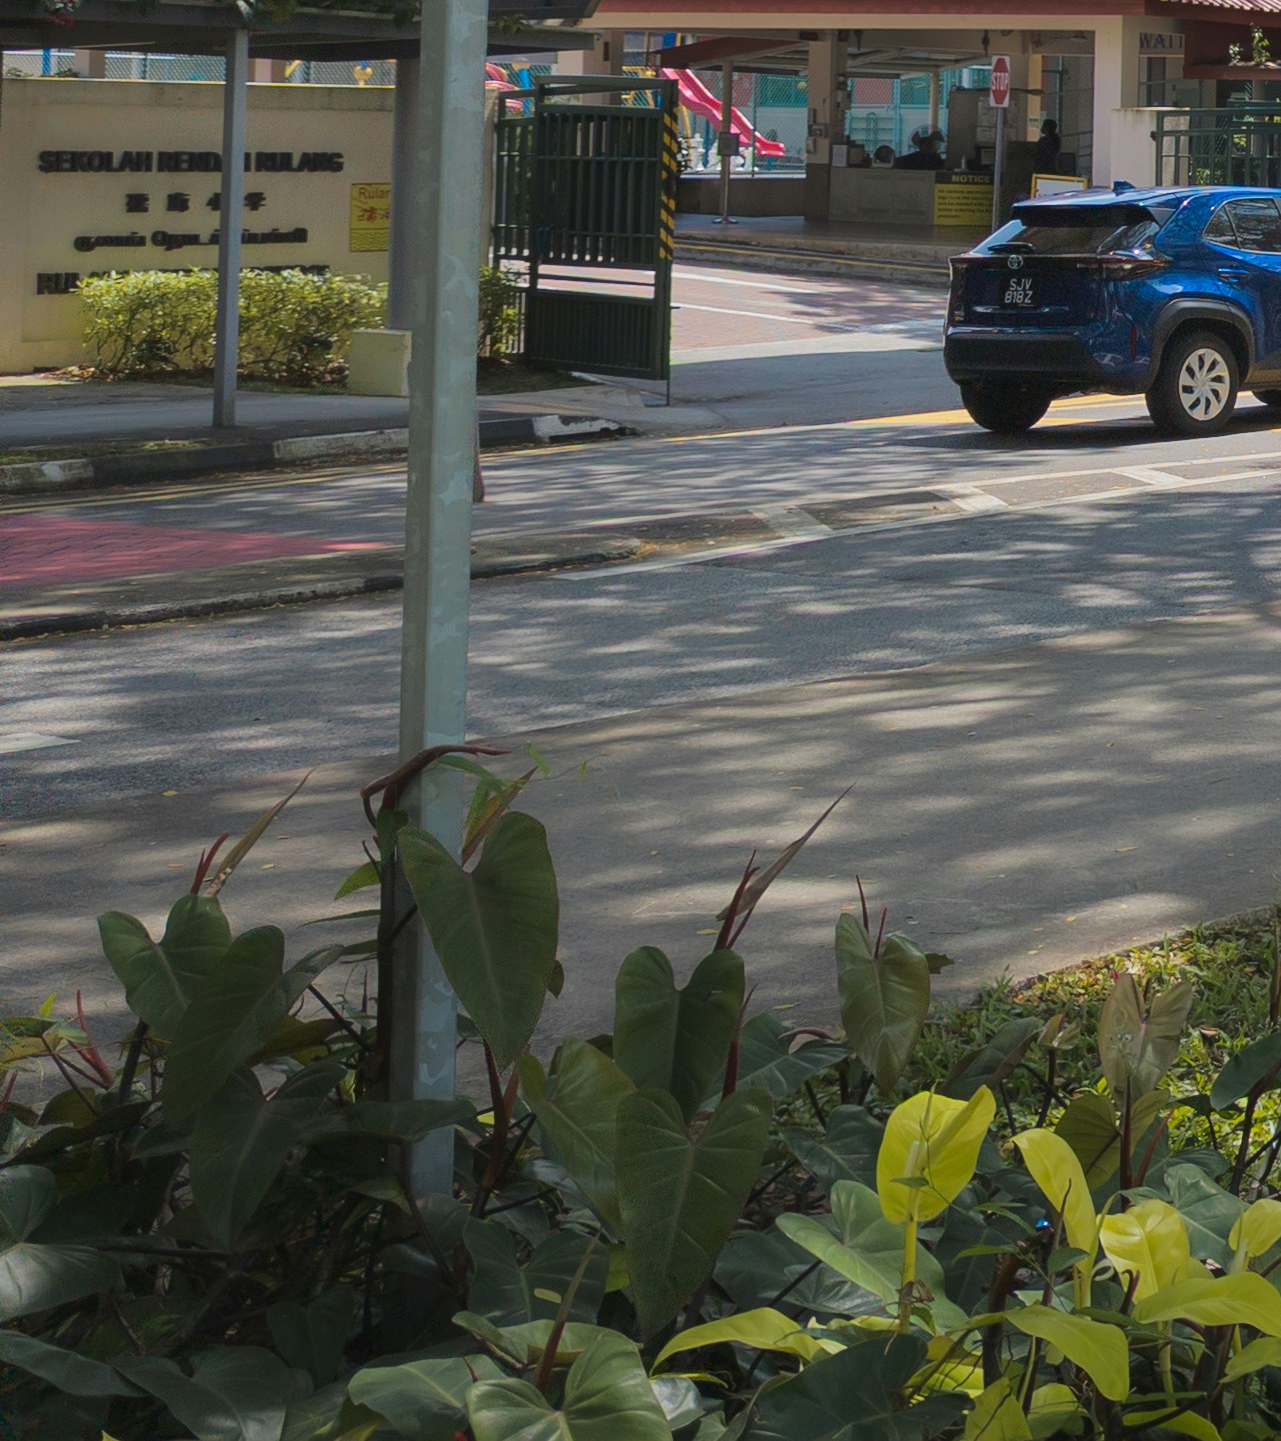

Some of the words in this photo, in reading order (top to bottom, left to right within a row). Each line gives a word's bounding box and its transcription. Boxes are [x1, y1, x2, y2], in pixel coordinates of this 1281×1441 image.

[992, 72, 1009, 91] STOP
[38, 150, 154, 173] SEKOLAH
[157, 151, 251, 173] REND
[951, 174, 991, 183] NOTICE
[1009, 278, 1033, 291] SJV
